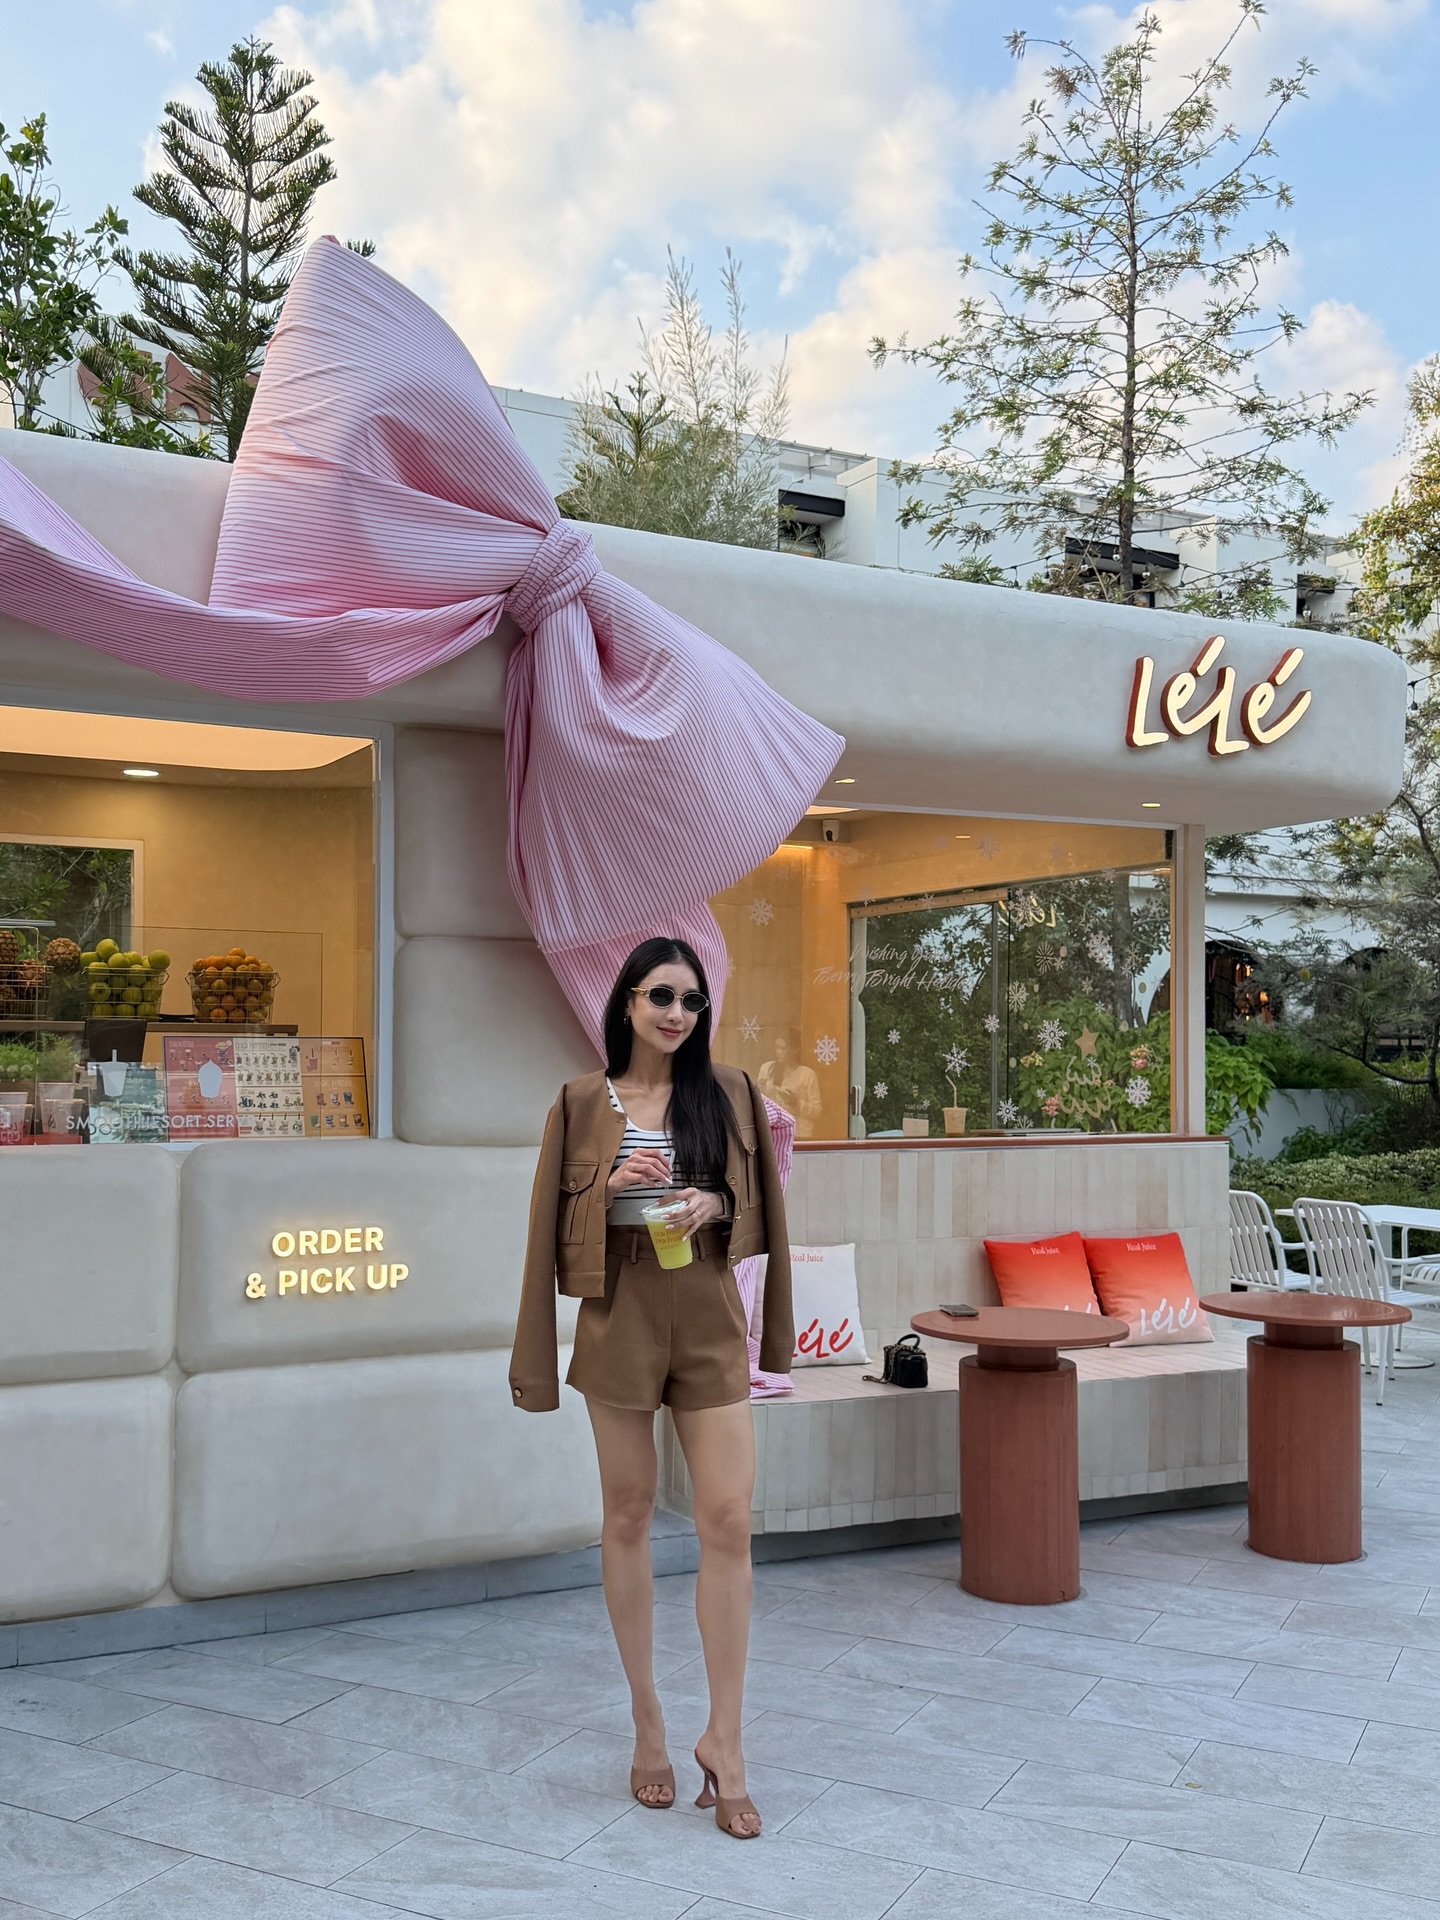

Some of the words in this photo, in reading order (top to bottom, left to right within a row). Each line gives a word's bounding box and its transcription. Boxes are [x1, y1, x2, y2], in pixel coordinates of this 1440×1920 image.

[813, 966, 863, 992] Berry
[864, 968, 917, 993] Bright
[162, 1114, 200, 1129] SOFT
[271, 1226, 385, 1258] ORDER
[1126, 1242, 1141, 1251] Real
[1141, 1242, 1157, 1251] Juice
[790, 1253, 805, 1262] Real
[806, 1254, 824, 1263] Juice
[1031, 1247, 1046, 1255] Real
[245, 1272, 267, 1299] &
[278, 1265, 356, 1296] PICK
[366, 1263, 409, 1291] UP
